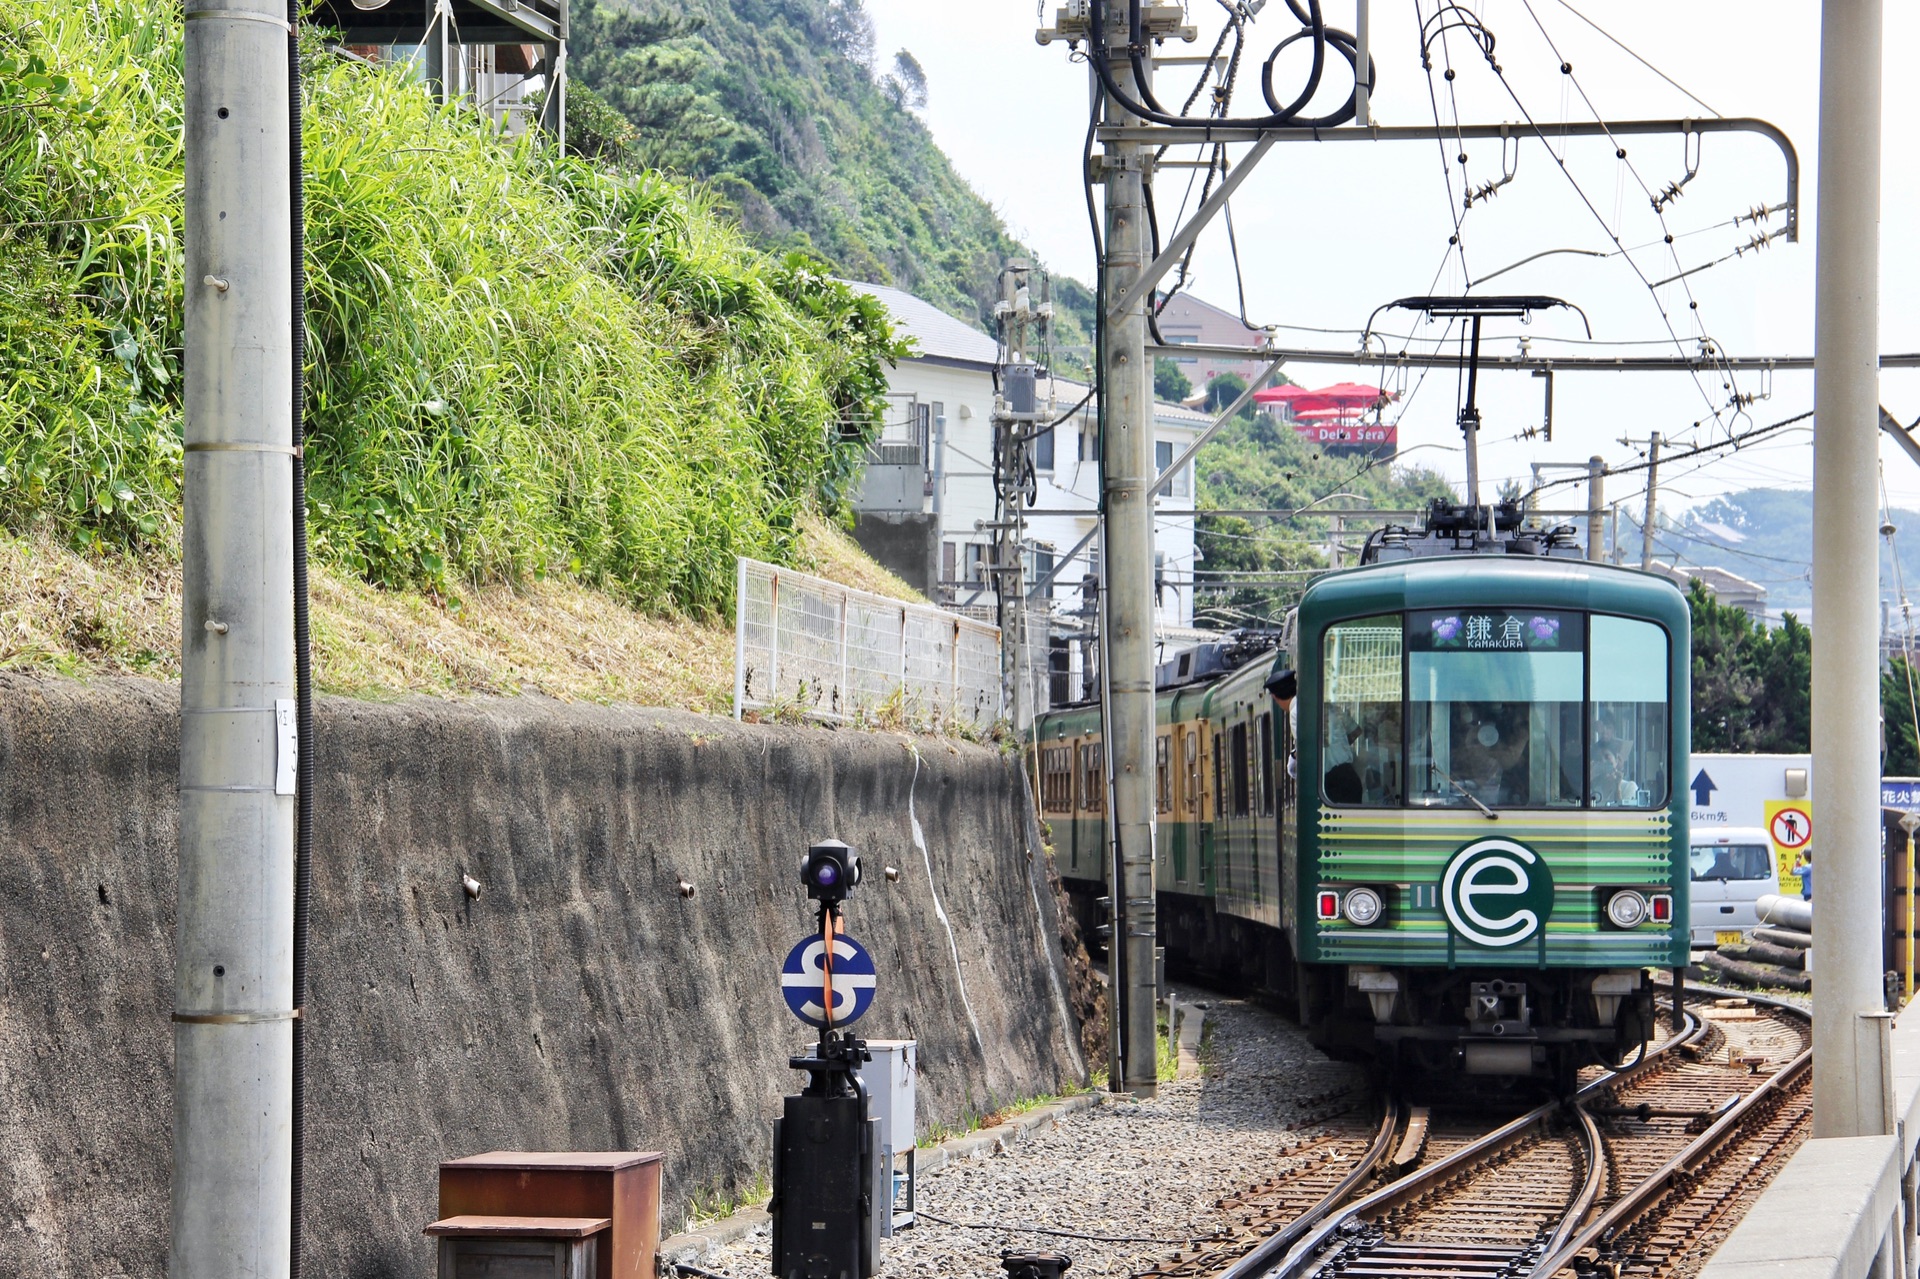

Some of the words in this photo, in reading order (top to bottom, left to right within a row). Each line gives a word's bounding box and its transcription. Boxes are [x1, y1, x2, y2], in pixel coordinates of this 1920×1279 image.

[1357, 429, 1384, 440] Sera
[1466, 615, 1524, 640] 鎌倉
[1467, 640, 1523, 648] KAMAKURA
